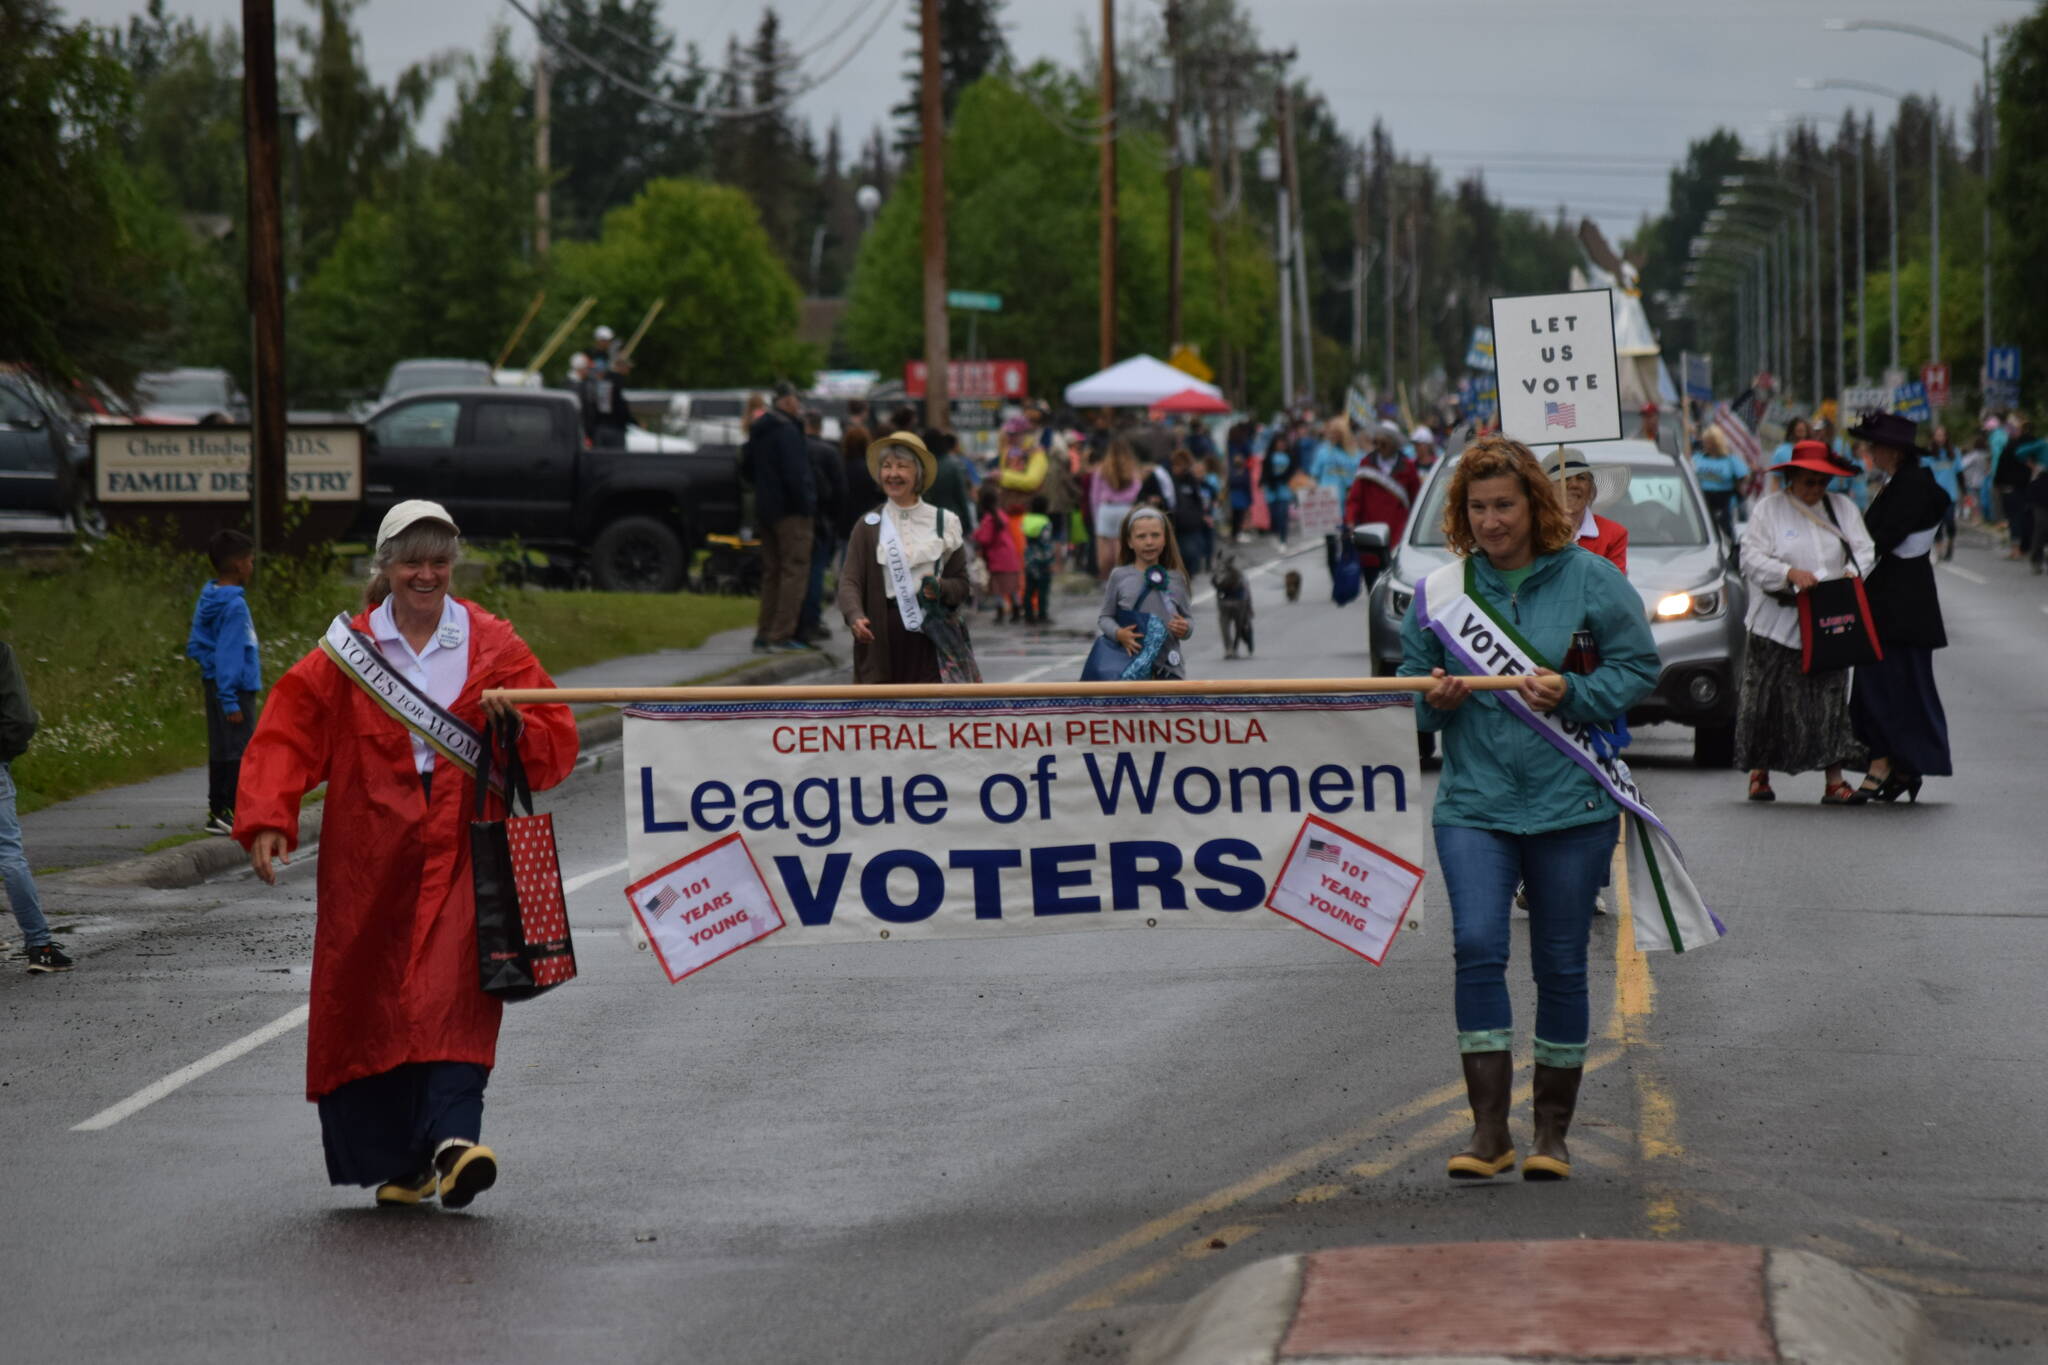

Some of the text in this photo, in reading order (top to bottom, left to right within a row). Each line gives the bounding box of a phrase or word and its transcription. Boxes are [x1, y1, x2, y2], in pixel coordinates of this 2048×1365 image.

[1530, 316, 1577, 334] LET
[1541, 345, 1573, 363] US
[1992, 350, 2014, 379] H
[1522, 374, 1598, 394] VOTE
[127, 435, 181, 457] Chris
[188, 433, 254, 456] Hudso
[107, 471, 353, 493] FAMILY DESTRY
[887, 538, 906, 583] VOTES
[905, 601, 920, 631] WO
[1459, 612, 1531, 676] VOTE
[341, 636, 481, 763] VOTES FOR WOM
[772, 718, 1268, 754] CENTRAL KENAI PENINSULA
[640, 751, 1407, 847] League of Women
[682, 877, 711, 899] 101
[773, 838, 1266, 927] VOTERS
[1340, 860, 1369, 882] 101
[680, 891, 733, 925] YEARS
[1320, 874, 1371, 908] YEARS
[688, 909, 749, 946] YOUNG
[1308, 893, 1367, 932] YOUNG
